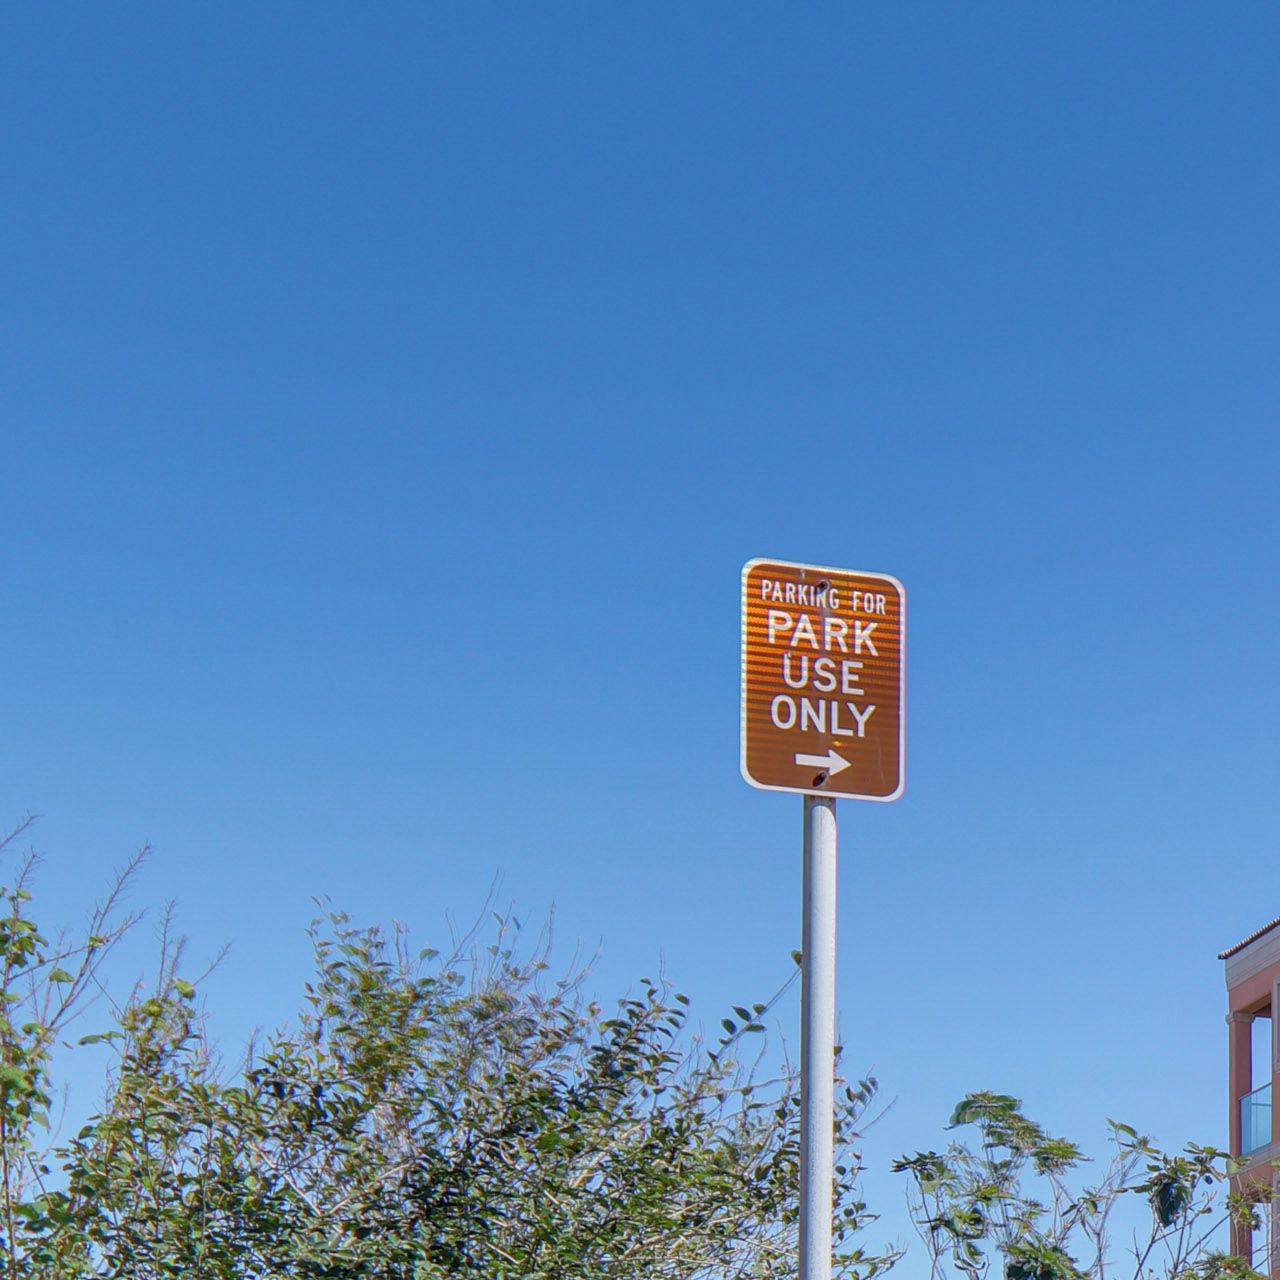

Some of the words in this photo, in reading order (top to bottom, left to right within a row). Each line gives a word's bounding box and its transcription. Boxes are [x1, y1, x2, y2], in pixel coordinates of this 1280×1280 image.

[761, 579, 840, 609] PARKING
[852, 591, 886, 615] FOR
[767, 609, 879, 656] PARK
[783, 654, 864, 695] USE
[770, 694, 876, 737] ONLY
